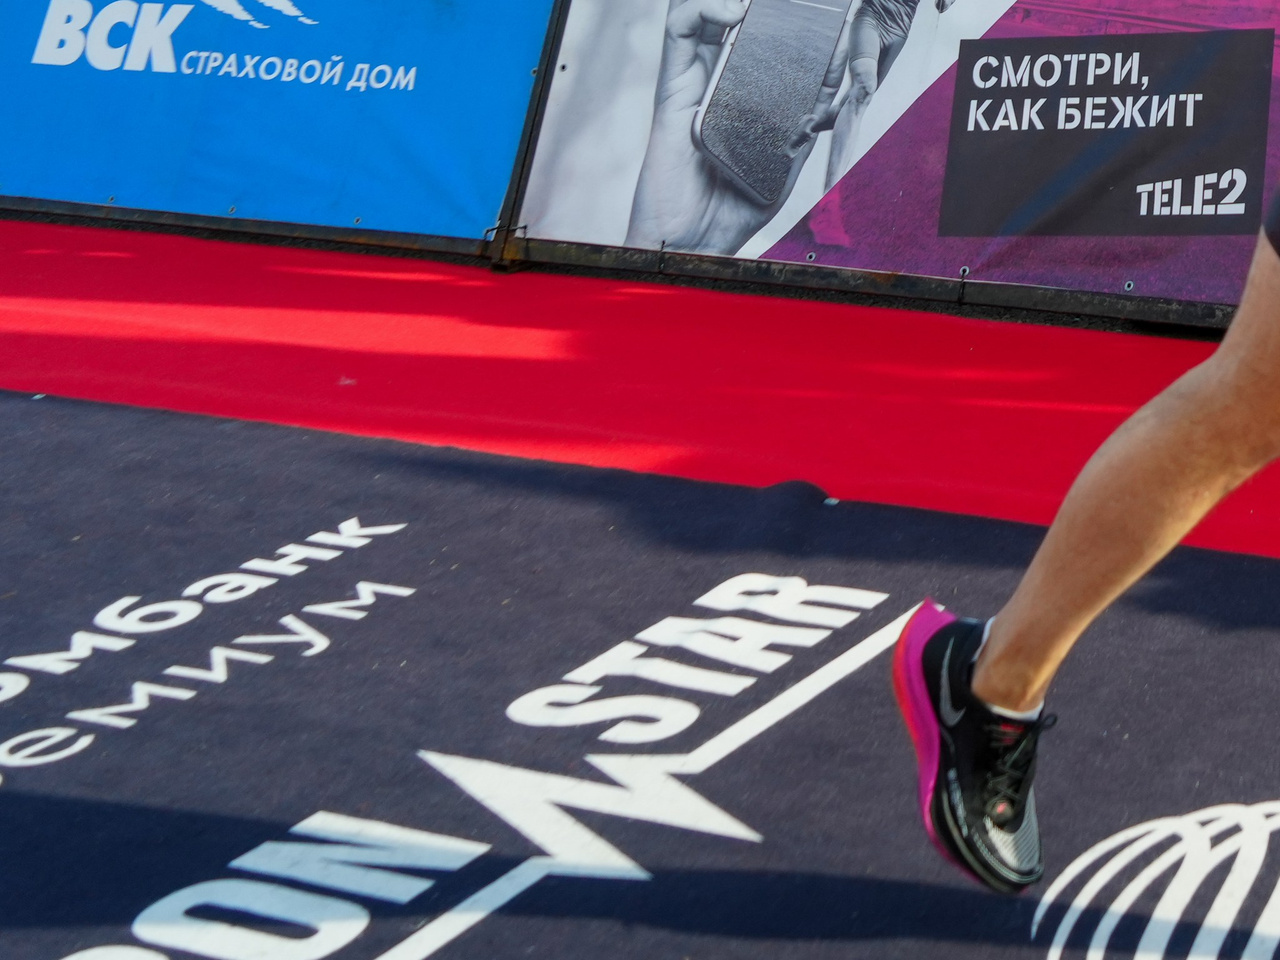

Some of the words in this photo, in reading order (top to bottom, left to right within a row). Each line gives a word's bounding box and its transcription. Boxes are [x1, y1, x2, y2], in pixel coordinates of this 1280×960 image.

[181, 50, 345, 86] СТРАХОВОЙ
[345, 63, 417, 92] ДОМ
[972, 52, 1149, 90] СМОТРИ,
[966, 98, 1047, 131] КАК
[1057, 93, 1203, 130] БЕЖИТ
[1136, 168, 1247, 216] TELE2
[0, 580, 416, 768] емиум
[505, 572, 890, 744] STAR
[60, 810, 492, 960] ON
